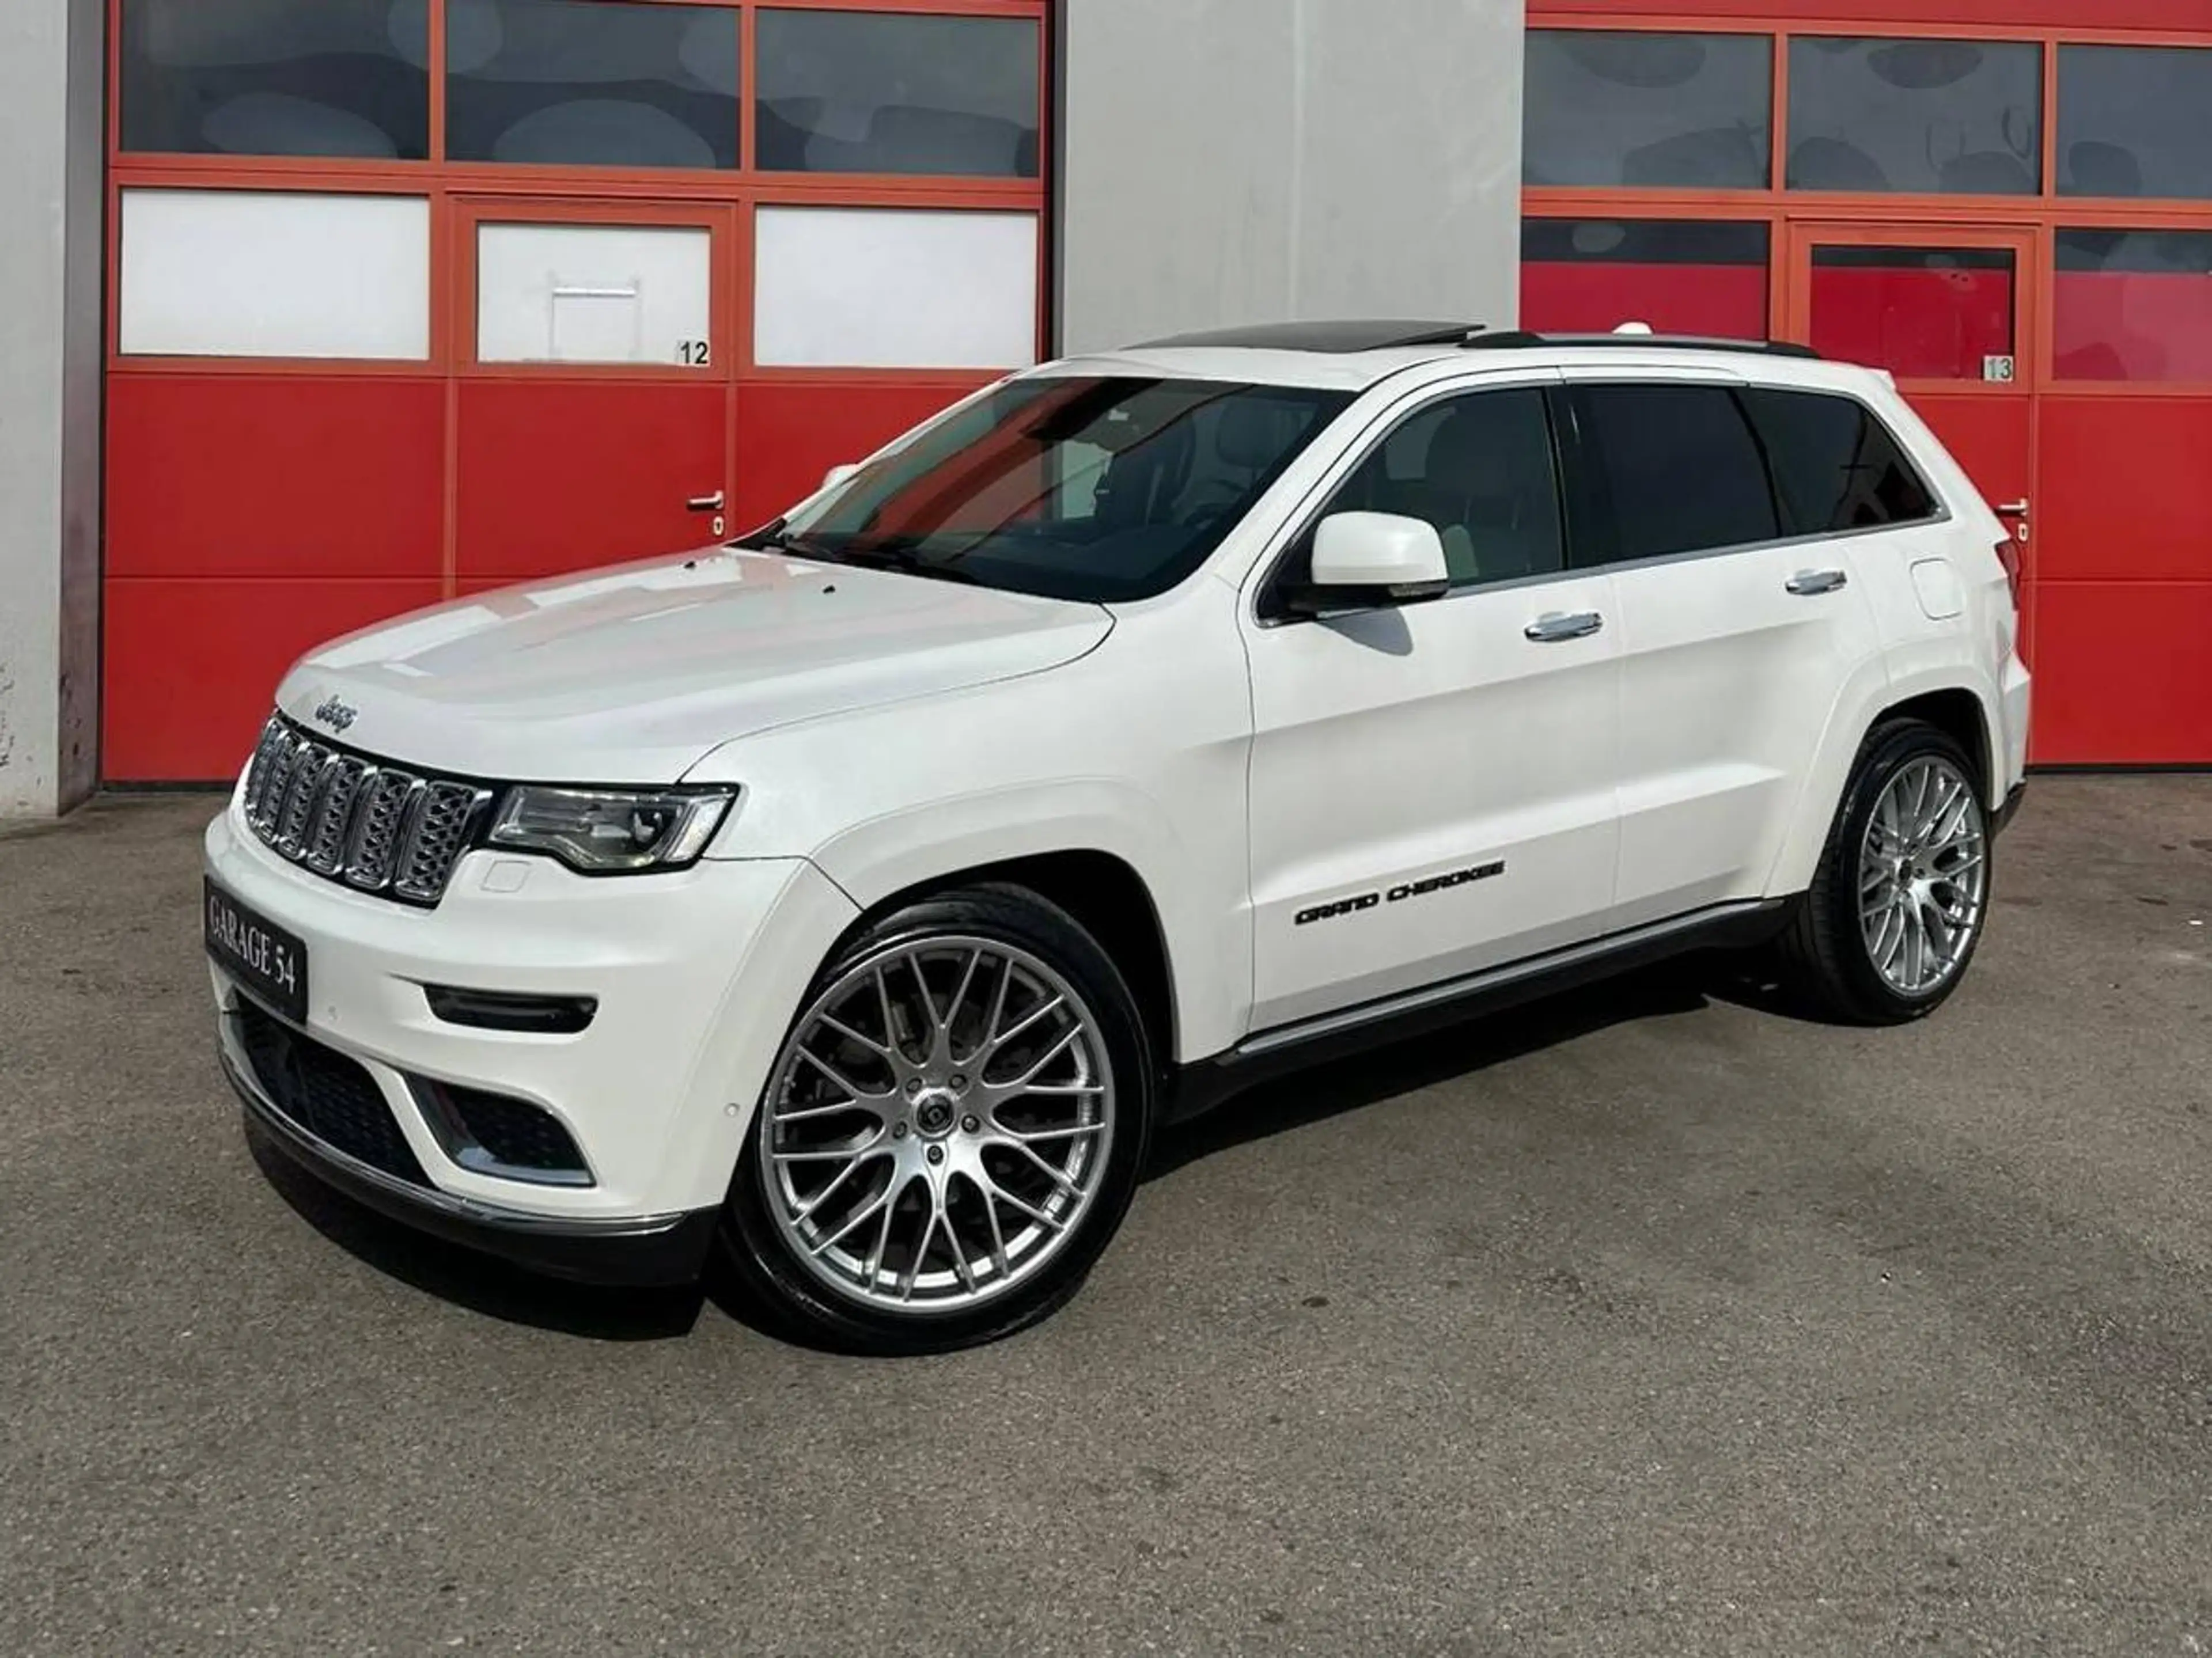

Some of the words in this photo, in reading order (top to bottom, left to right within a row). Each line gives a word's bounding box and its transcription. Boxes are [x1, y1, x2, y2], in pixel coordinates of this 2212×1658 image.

[680, 341, 707, 364] 12
[1988, 358, 2011, 379] 13
[1295, 892, 1380, 925] GRAND
[1387, 860, 1505, 902] CHEROKEE
[210, 895, 271, 975] GARAGE
[276, 944, 296, 995] 54
